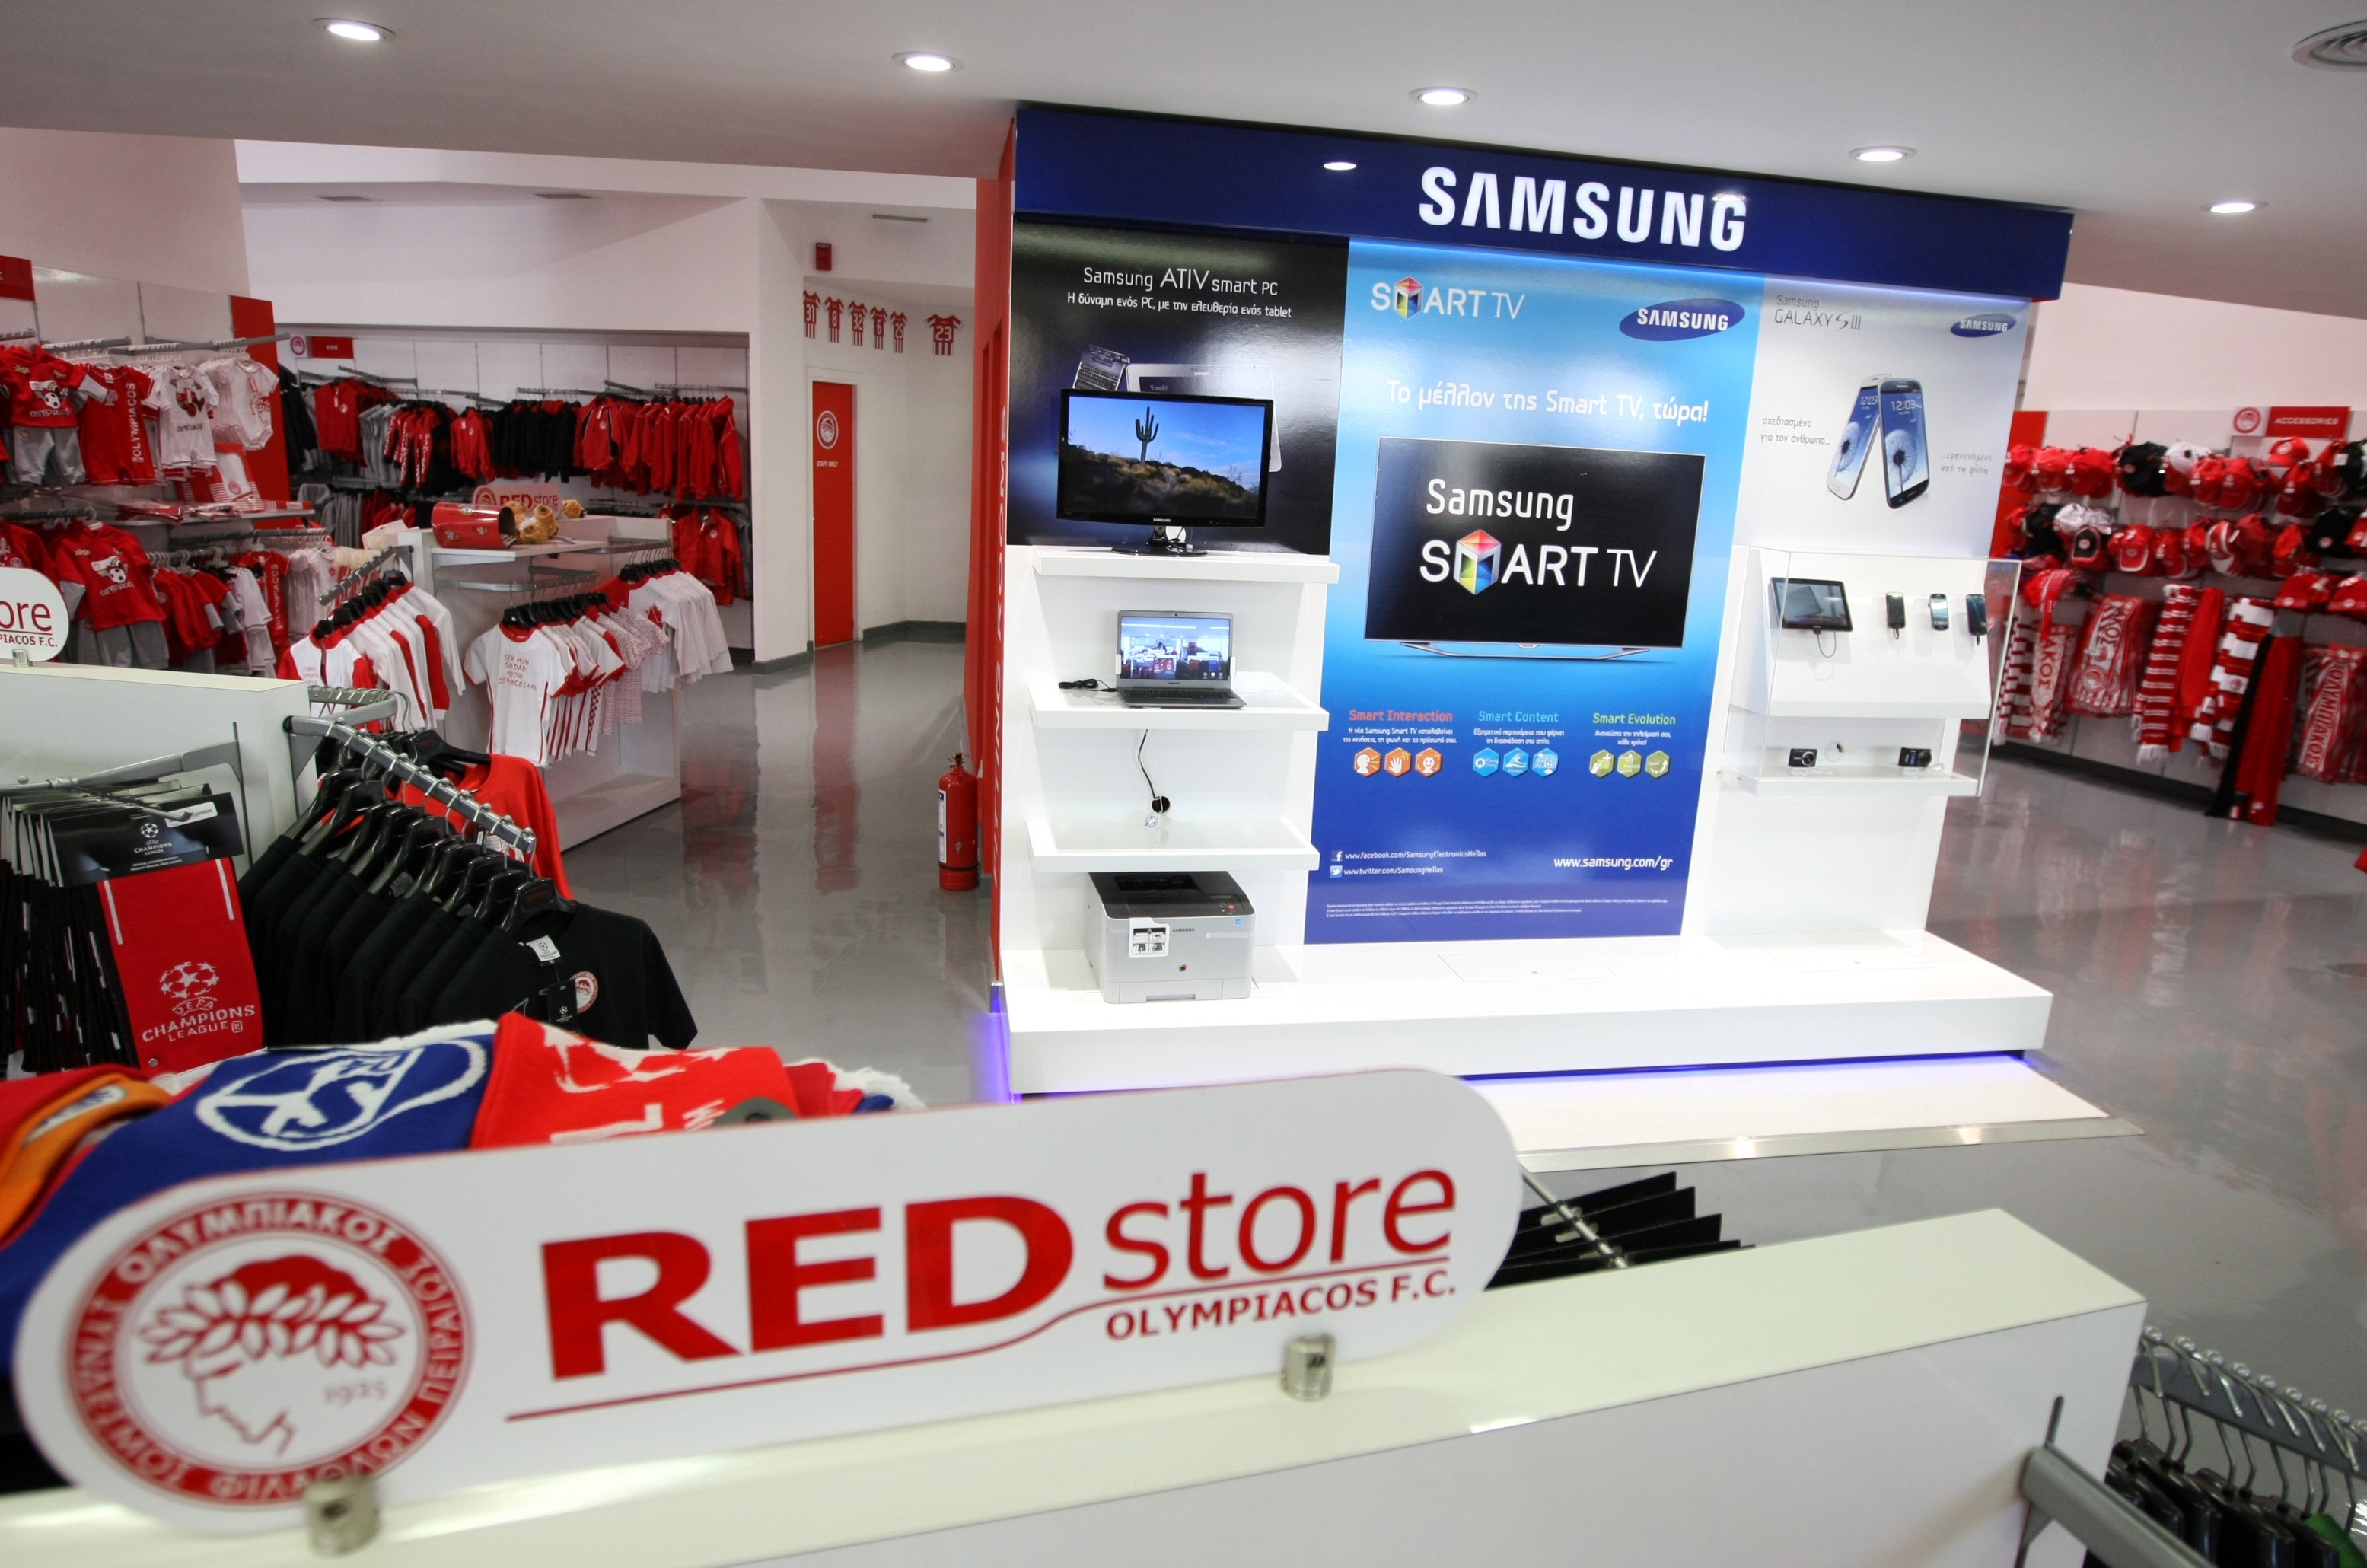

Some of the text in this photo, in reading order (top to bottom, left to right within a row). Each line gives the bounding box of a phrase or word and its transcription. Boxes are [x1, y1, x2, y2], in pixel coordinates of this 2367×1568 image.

[1419, 166, 1747, 252] SAMSUNG
[1084, 267, 1278, 295] Samsung ATIV smart PC
[1078, 293, 1113, 308] δύναμη
[1117, 295, 1138, 308] ενός
[1142, 297, 1155, 311] PC,
[1158, 301, 1170, 312] με
[1174, 301, 1188, 312] την
[1191, 301, 1238, 317] ελευθερία
[1241, 304, 1262, 316] ενός
[1265, 305, 1292, 318] tablet
[1493, 292, 1525, 320] TV
[1776, 294, 1820, 311] Samsung
[806, 304, 816, 323] 31
[831, 310, 838, 327] 8
[853, 313, 863, 331] 32
[1636, 308, 1729, 332] SAMSUNG
[1774, 308, 1834, 328] GALAXY
[876, 318, 883, 336] 6
[935, 325, 952, 342] 23
[1959, 319, 2009, 333] SAMSUNG
[1386, 379, 1709, 428] Το μέλλον της Smart TV, τώρα!
[1891, 400, 1916, 412] 12:03
[2275, 417, 2340, 425] ACCESSORIES
[1426, 478, 1575, 531] Samsung
[1606, 548, 1658, 588] TV
[39, 636, 58, 648] F.C.
[1349, 709, 1453, 722] Smart Interaction
[1478, 710, 1559, 722] Smart Content
[1592, 712, 1677, 725] Smart Evolution
[1365, 727, 1390, 736] Samsung
[134, 842, 173, 853] CHAMPIONS
[1553, 855, 1674, 871] www.samsung.com/gr
[142, 1005, 255, 1042] CHAMPIONS
[169, 1021, 228, 1041] LEAGUE
[116, 1197, 400, 1284] ΟΛΥΜΠΙΑΚΟΣ
[542, 1168, 1457, 1380] RED store
[1105, 1270, 1457, 1342] OLYMPIACOS F.C.
[323, 1381, 390, 1406] 1925
